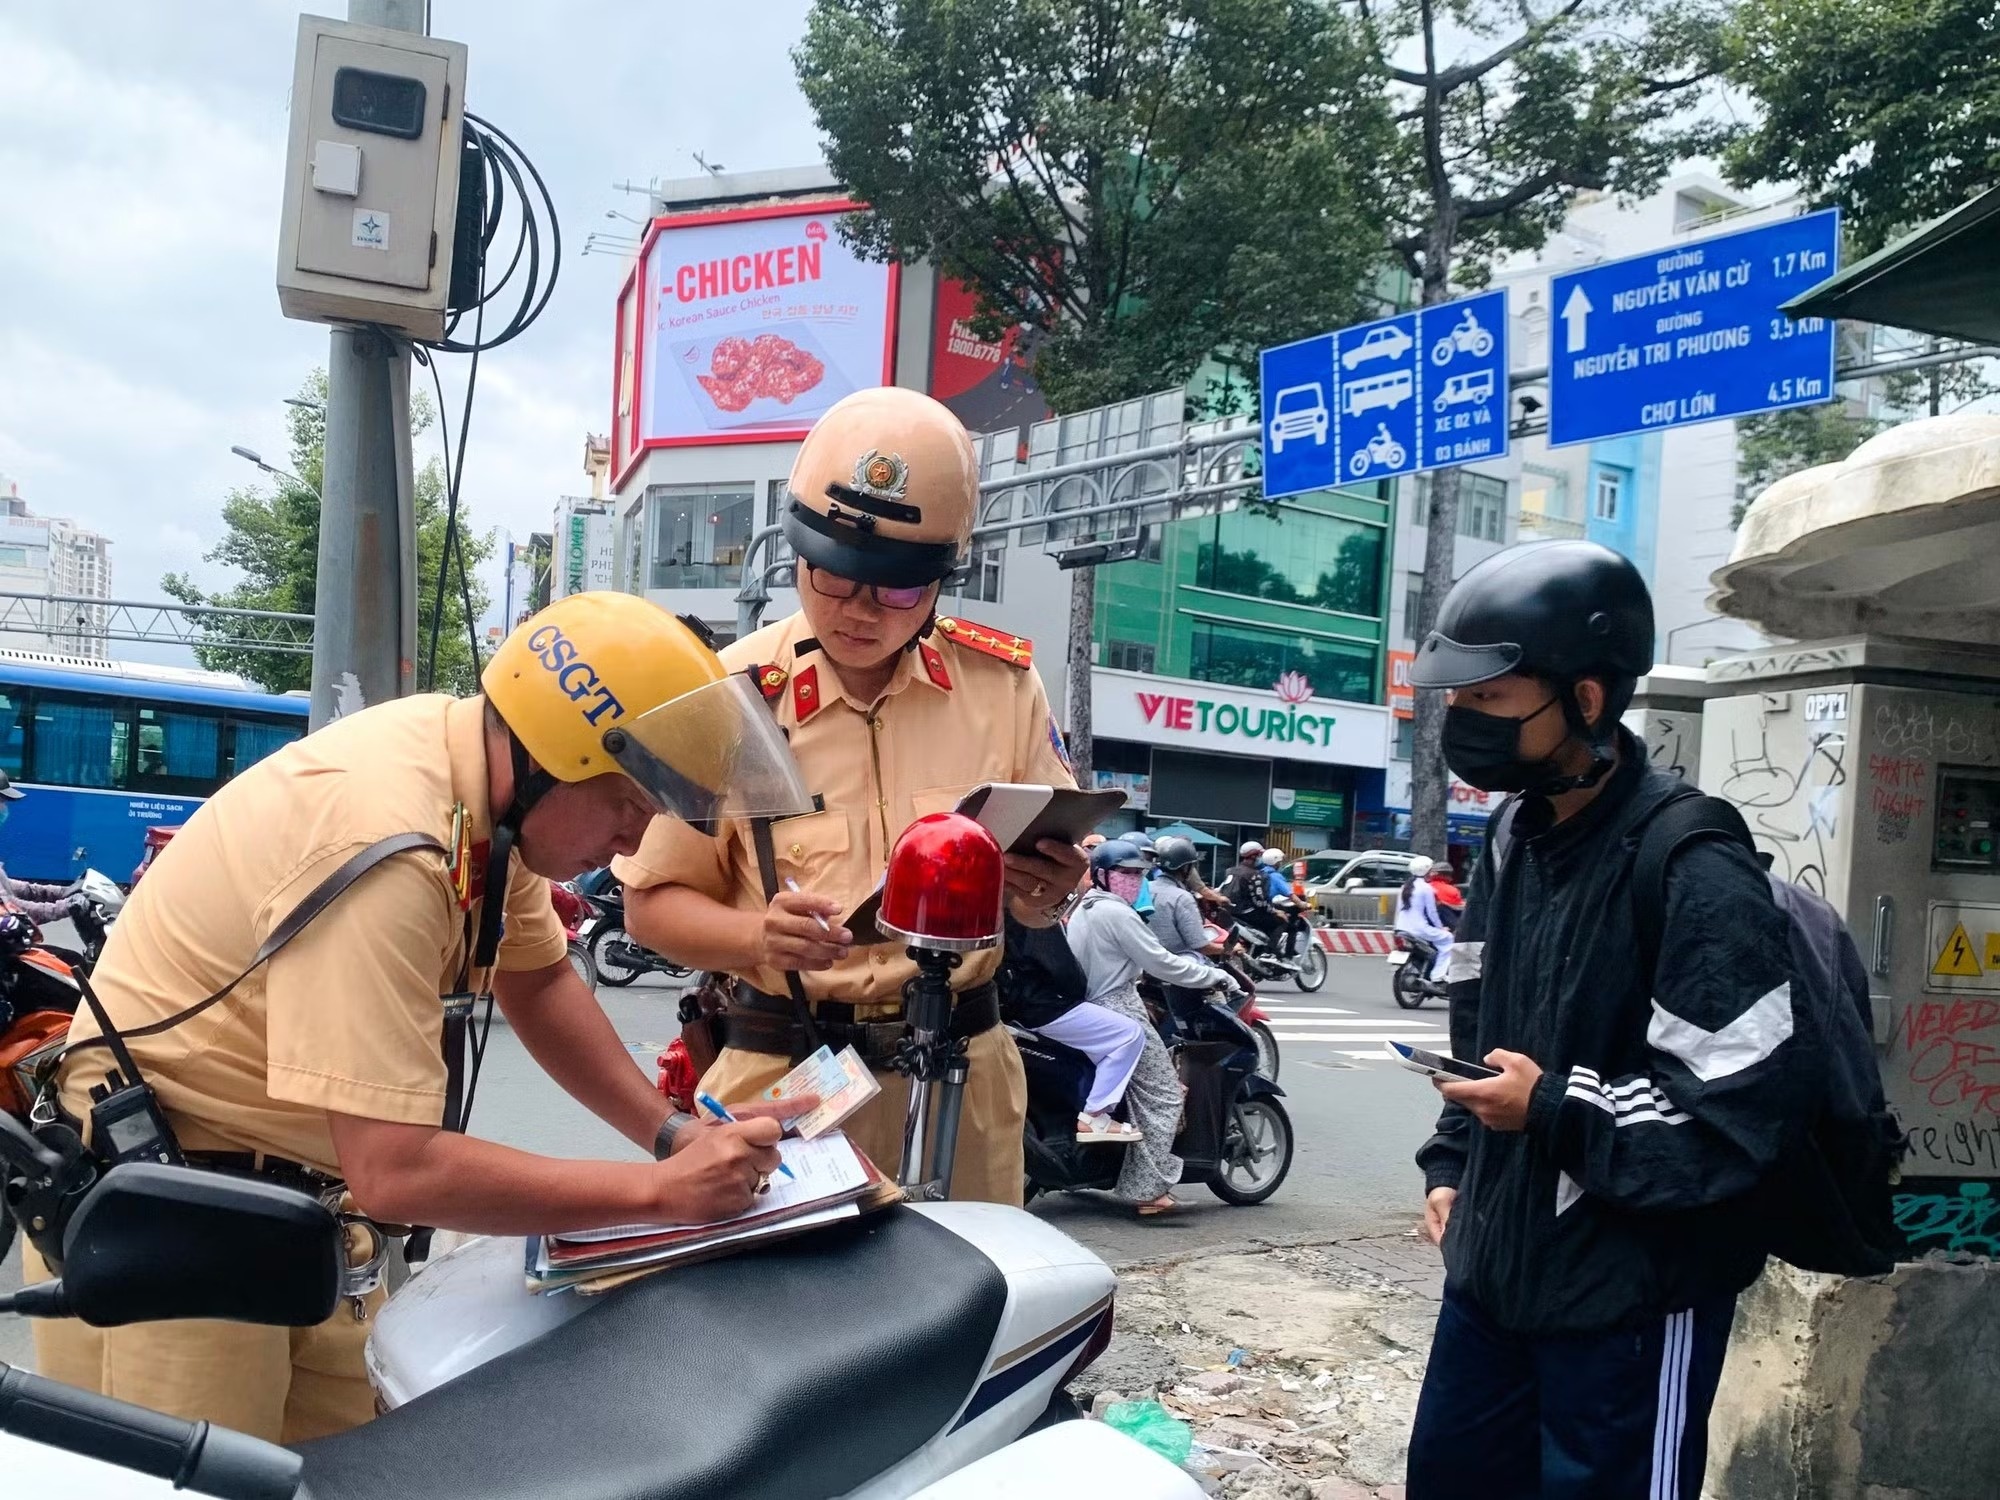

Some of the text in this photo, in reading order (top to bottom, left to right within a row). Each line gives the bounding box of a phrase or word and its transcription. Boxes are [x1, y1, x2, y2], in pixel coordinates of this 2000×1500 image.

[1657, 249, 1704, 275] ĐƯỜNG
[1772, 249, 1826, 279] 1,7 Km
[1612, 276, 1680, 314] NGUYỄN
[1686, 270, 1721, 294] VĂN
[669, 312, 704, 328] Korean
[706, 303, 738, 320] Sauce
[740, 292, 781, 312] Chicken
[1656, 310, 1703, 334] ĐƯỜNG
[1798, 316, 1824, 335] Km
[1573, 324, 1750, 380] NGUYỄN TRI PHƯƠNG
[1767, 377, 1821, 403] 4,5 Km
[1435, 405, 1492, 433] XE 02 VÀ
[1641, 391, 1716, 426] CHỢ LỚN
[1435, 437, 1491, 462] 03 BÁNH
[528, 625, 626, 728] CSGT
